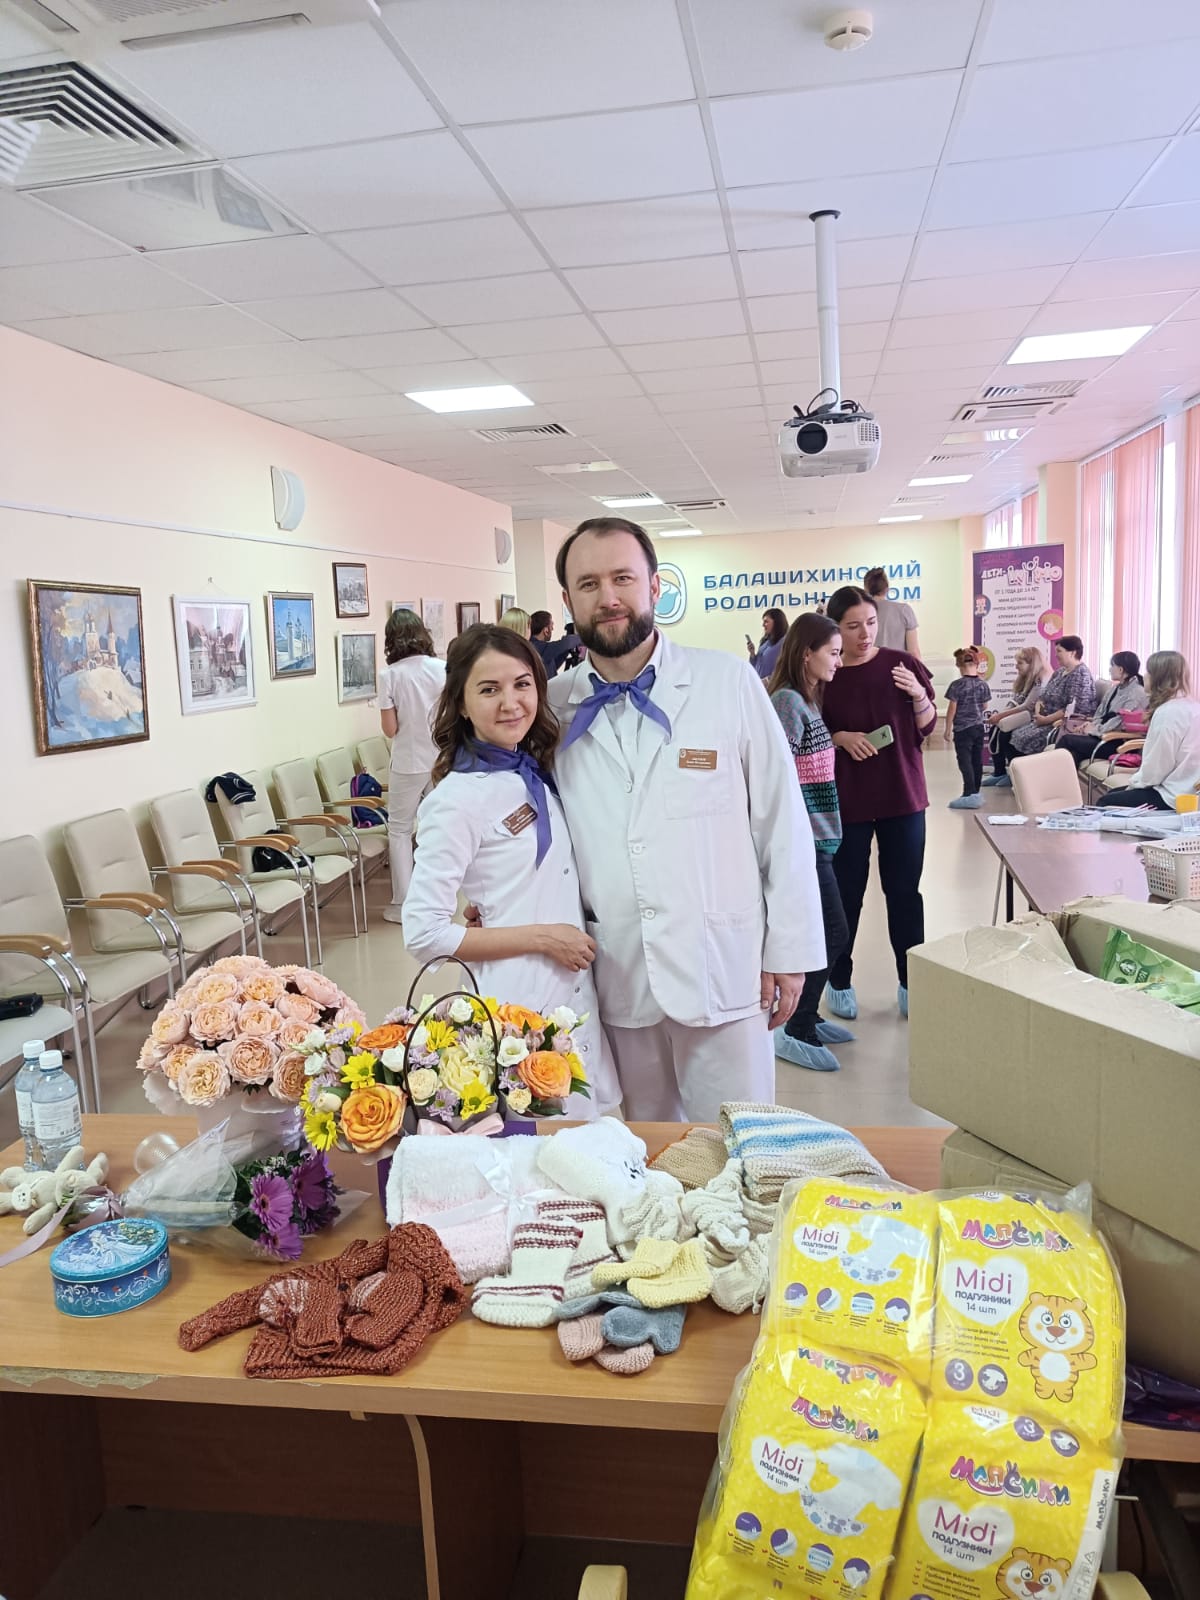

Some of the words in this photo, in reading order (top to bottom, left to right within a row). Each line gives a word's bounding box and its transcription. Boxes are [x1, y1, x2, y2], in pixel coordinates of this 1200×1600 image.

[703, 560, 921, 589] БАЛАШИХИНСИЙ
[704, 591, 834, 611] РОДИЛЬН
[886, 586, 921, 600] ОМ
[802, 1227, 840, 1244] Midi
[956, 1266, 1012, 1294] Midi
[966, 1302, 976, 1312] 14
[953, 1362, 965, 1381] 3
[1023, 1418, 1036, 1434] 3
[761, 1441, 804, 1474] Midi
[934, 1506, 998, 1546] Midi
[943, 1545, 953, 1554] 14
